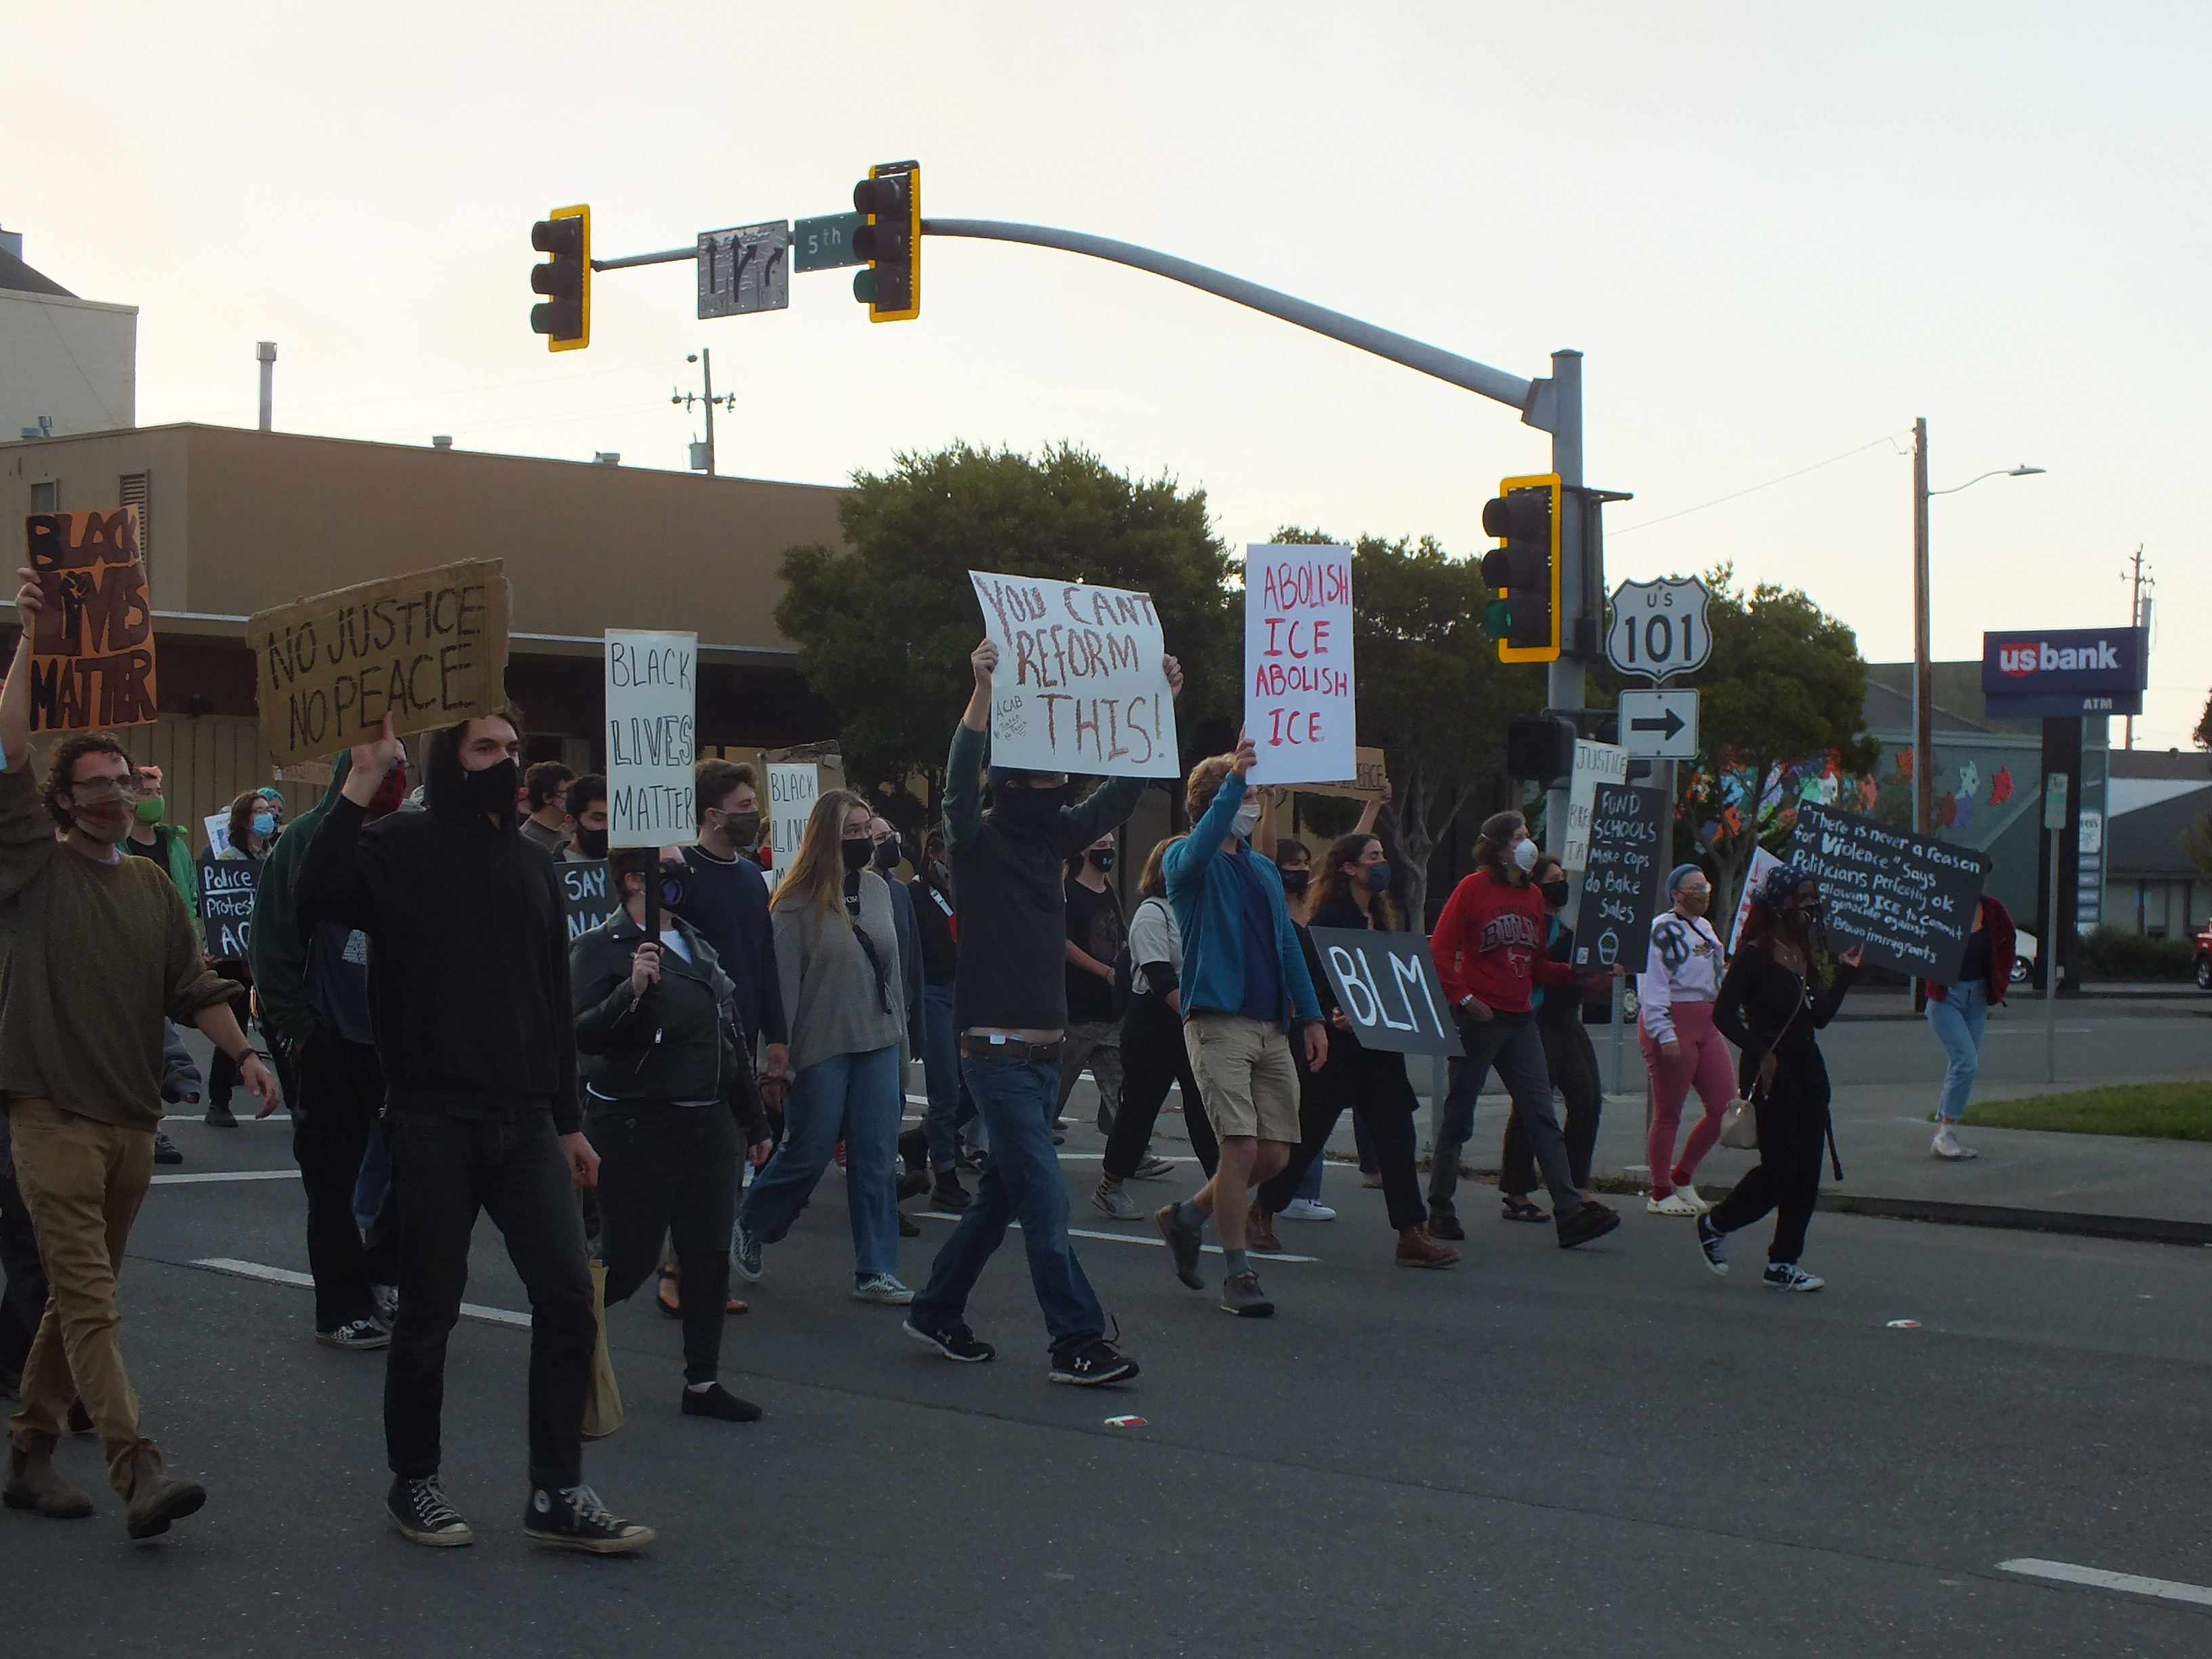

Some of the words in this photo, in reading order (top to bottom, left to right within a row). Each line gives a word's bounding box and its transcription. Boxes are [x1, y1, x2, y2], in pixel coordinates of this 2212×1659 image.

[808, 226, 842, 255] 5th
[26, 507, 140, 571] BLACK
[1264, 562, 1349, 611] ABOLISH
[1646, 592, 1673, 608] US
[33, 565, 149, 656] LIVES
[974, 574, 1047, 652] YOU
[1063, 586, 1155, 627] CANT
[268, 621, 316, 690] NO
[327, 586, 485, 665] JUSTICE
[1016, 623, 1141, 689] REFORM
[1264, 617, 1330, 657] ICE
[1625, 613, 1693, 663] 101
[611, 642, 692, 693] BLACK
[1255, 663, 1349, 698] ABOLISH
[30, 651, 157, 731] MATTER
[289, 684, 327, 751] NO
[335, 643, 473, 736] PEACE
[996, 695, 1023, 722] ACAB
[2083, 697, 2113, 710] ATM
[611, 715, 693, 767] LIVES
[1036, 692, 1165, 764] THIS!
[1267, 708, 1325, 745] ICE
[1576, 745, 1627, 777] JUSTICE
[613, 785, 695, 832] MATTER
[771, 773, 816, 802] BLACK
[1601, 790, 1641, 817] FUND
[773, 818, 808, 853] LIV
[1593, 819, 1657, 843] SCHOOLS
[1853, 823, 1867, 838] is
[1869, 830, 1909, 851] never
[1912, 844, 1923, 858] a
[1926, 846, 1981, 874] reason
[204, 865, 253, 890] Police
[1794, 823, 1816, 844] for
[1902, 862, 1937, 891] Says
[565, 867, 606, 901] SAY
[1584, 871, 1601, 894] do
[1605, 870, 1641, 895] Bake
[1598, 897, 1635, 924] Sales
[1328, 945, 1446, 1038] BLM
